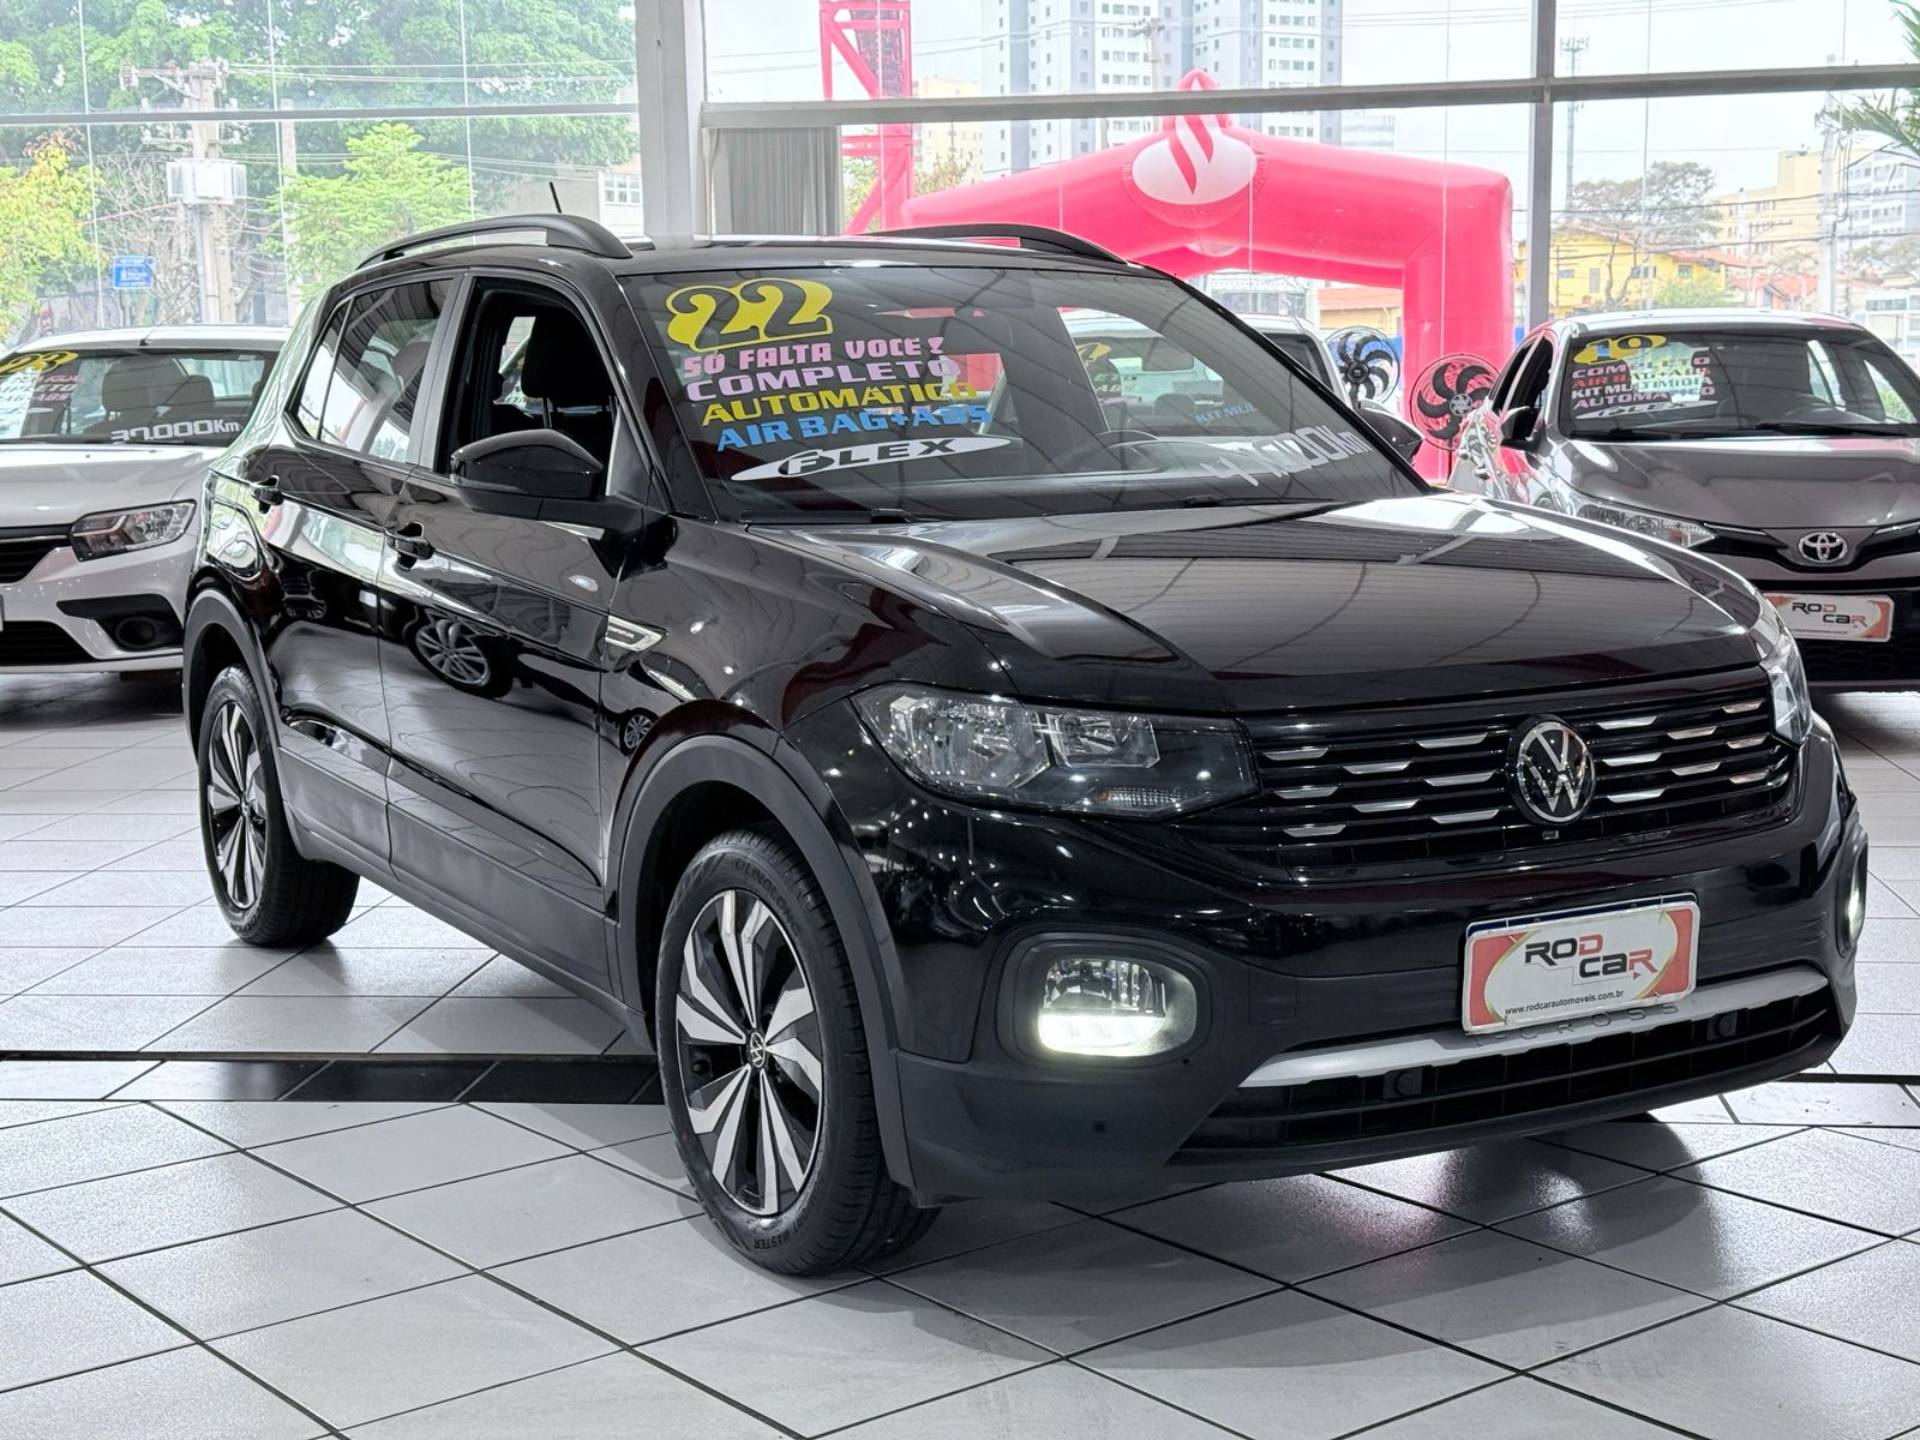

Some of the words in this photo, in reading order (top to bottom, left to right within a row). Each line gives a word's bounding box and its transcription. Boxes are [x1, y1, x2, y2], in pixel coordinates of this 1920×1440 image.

[666, 277, 833, 352] 22
[739, 341, 833, 370] FALTA
[686, 359, 961, 402] COMPLETO
[1571, 387, 1602, 400] KIT
[717, 420, 793, 451] AIR
[779, 439, 955, 476] FLEX
[1792, 602, 1837, 615] ROD
[1525, 934, 1603, 966] ROD
[1504, 990, 1625, 1016] www.rodcarautomoveis.com.br
